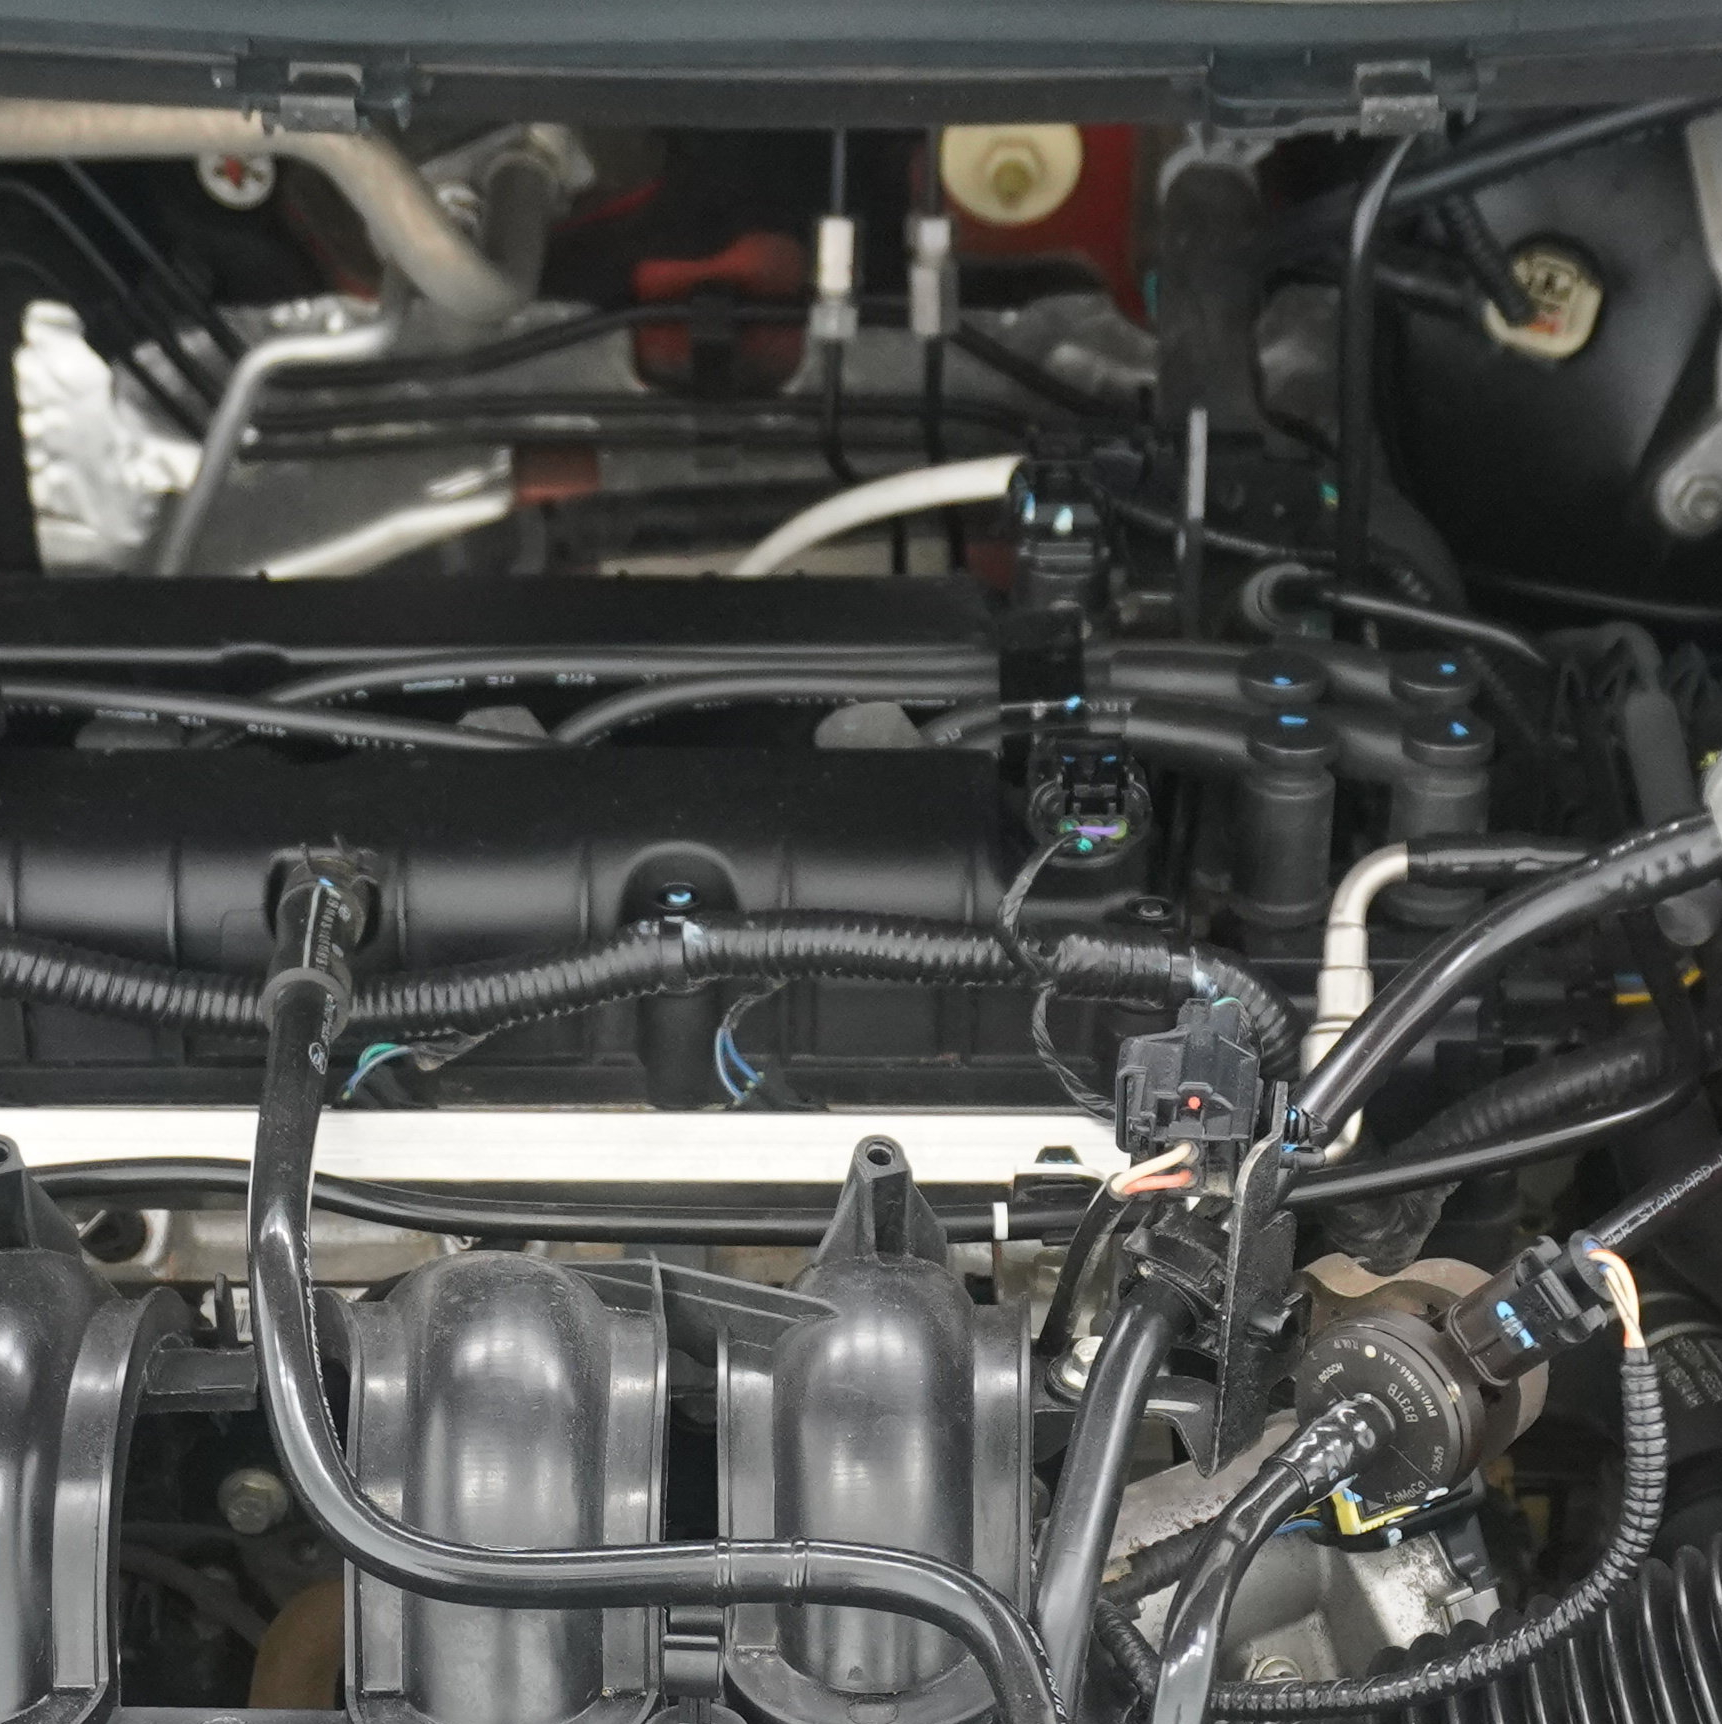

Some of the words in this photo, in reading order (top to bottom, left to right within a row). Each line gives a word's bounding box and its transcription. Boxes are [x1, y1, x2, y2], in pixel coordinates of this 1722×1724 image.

[1317, 1362, 1345, 1384] BOSCH
[1387, 1382, 1419, 1424] B33TB
[1384, 1479, 1427, 1504] FoMoCo
